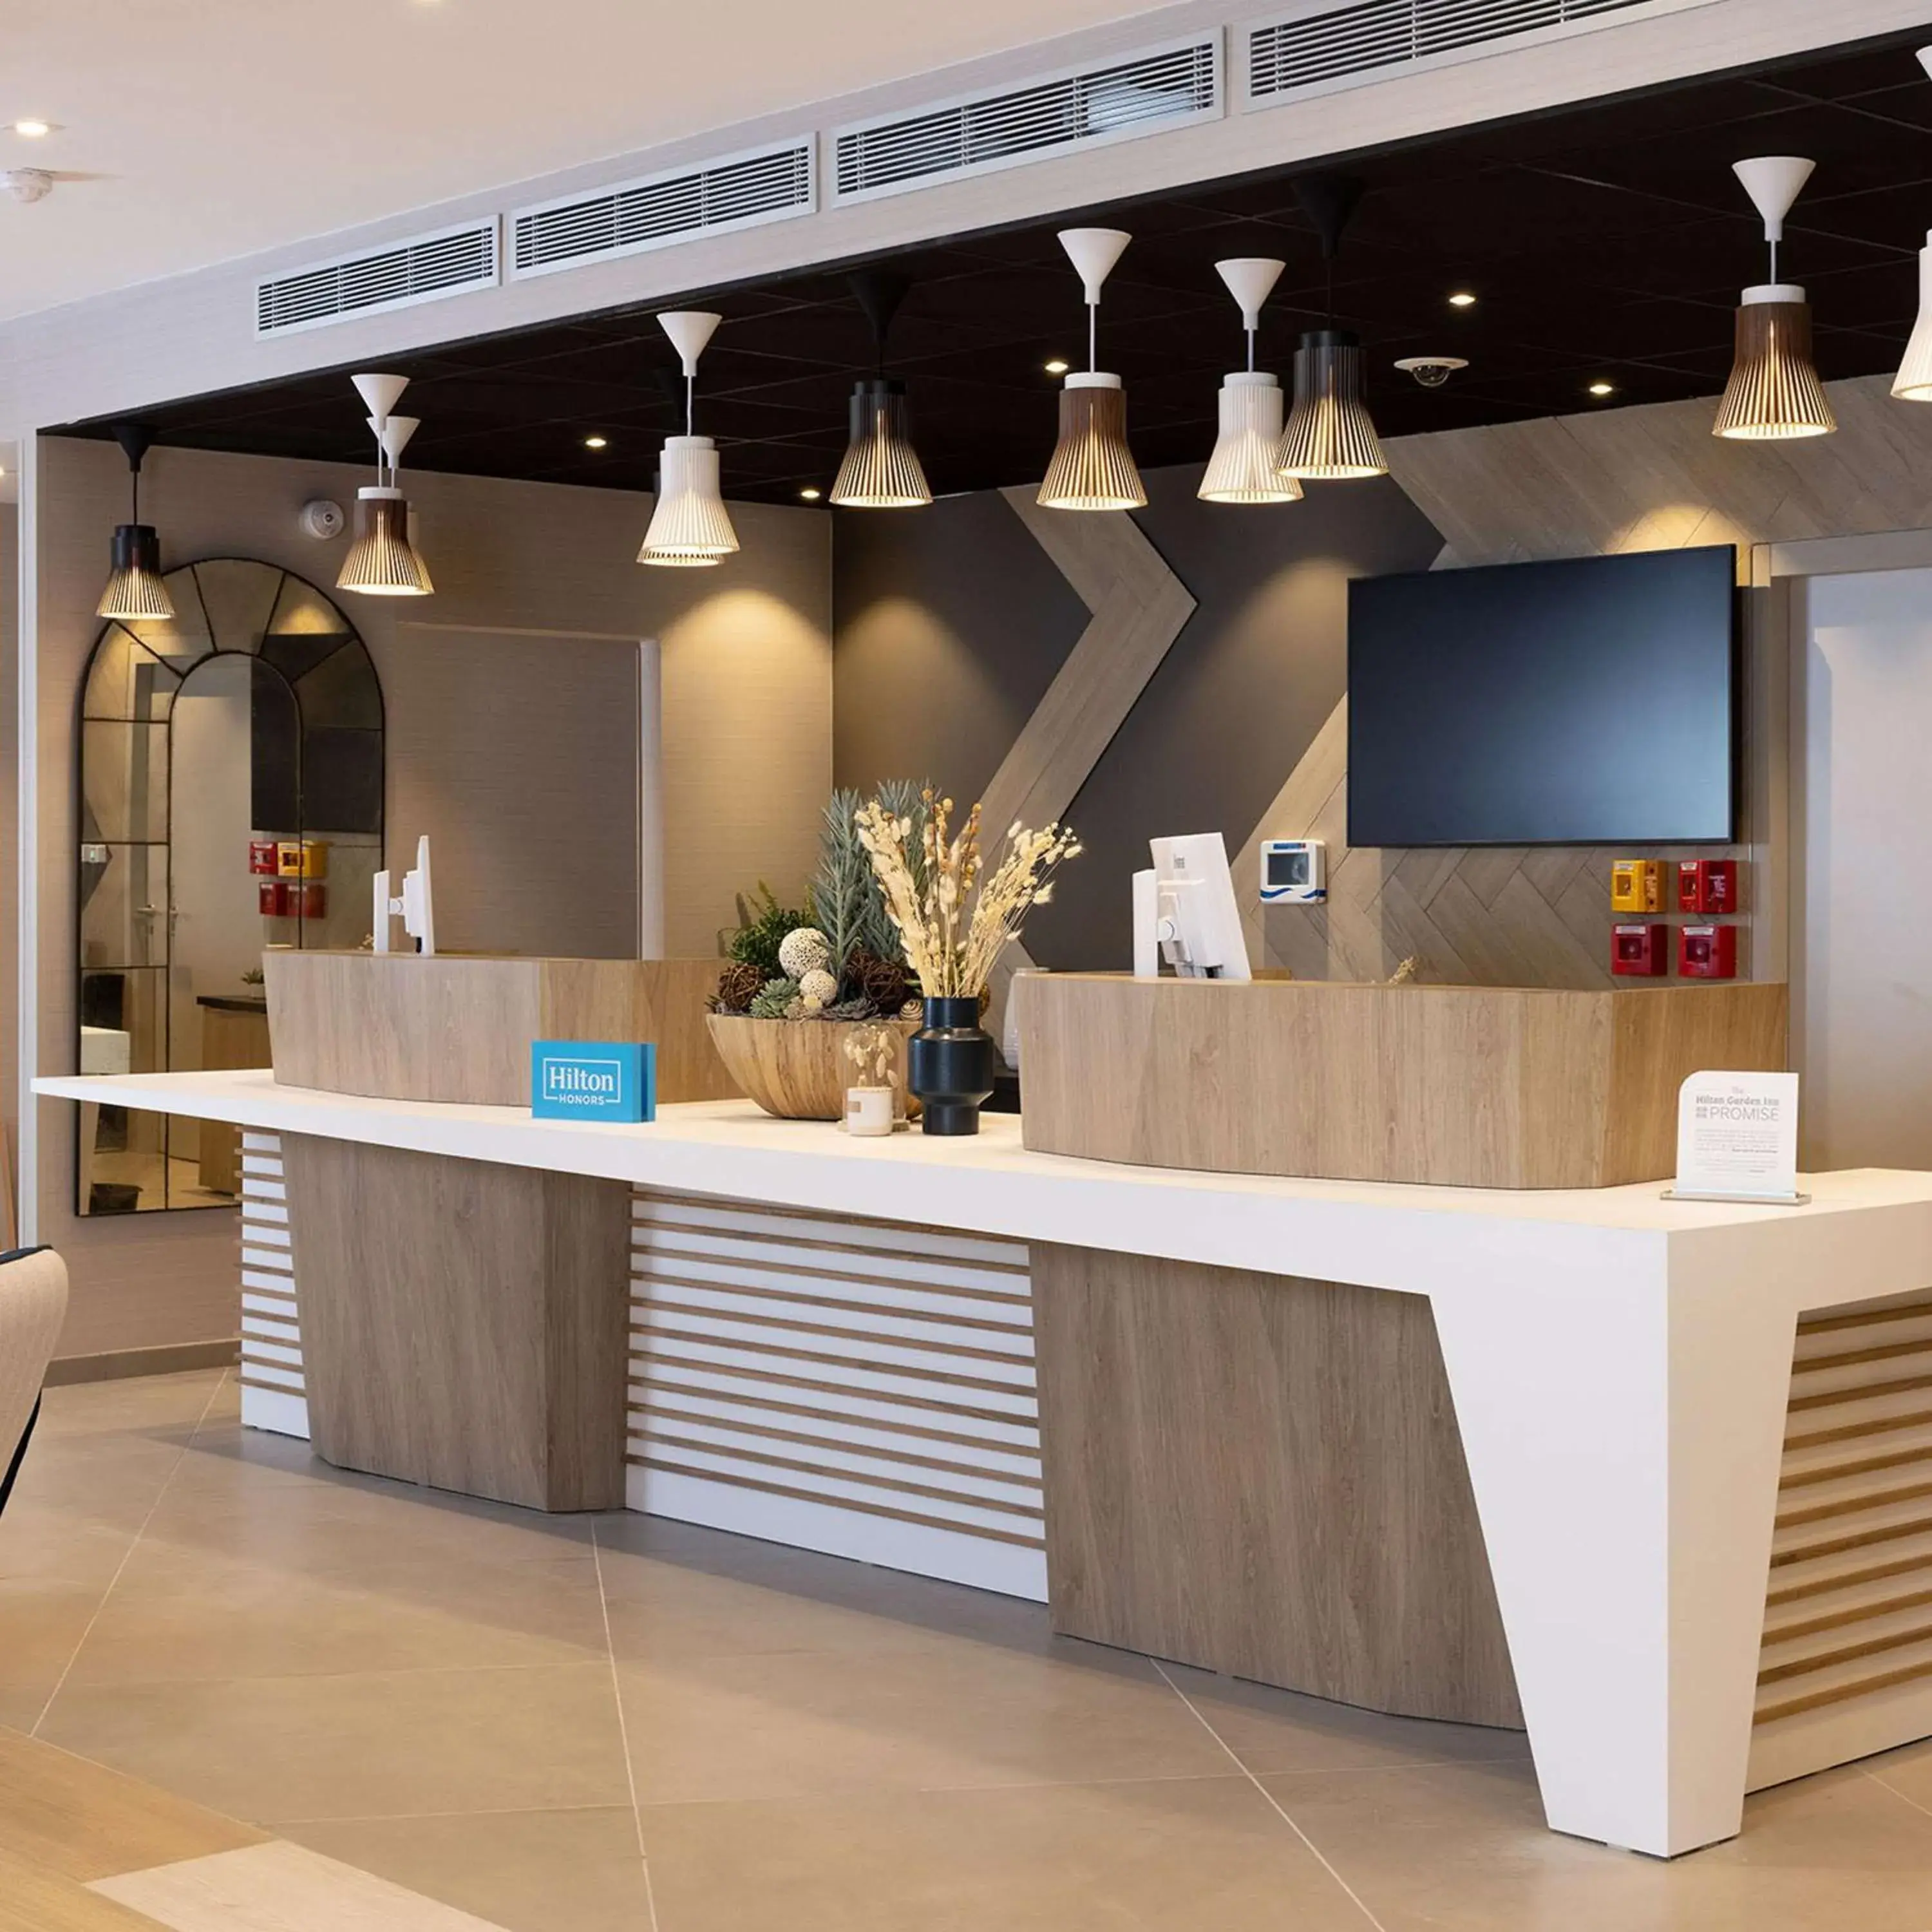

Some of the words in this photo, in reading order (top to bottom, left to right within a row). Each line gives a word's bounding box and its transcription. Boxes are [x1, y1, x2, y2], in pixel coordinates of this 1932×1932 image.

[549, 1066, 614, 1091] Hilton
[559, 1094, 605, 1106] HONORS
[1696, 1095, 1725, 1104] Hilton
[1727, 1096, 1761, 1105] Garden
[1710, 1106, 1779, 1121] PROMISE
